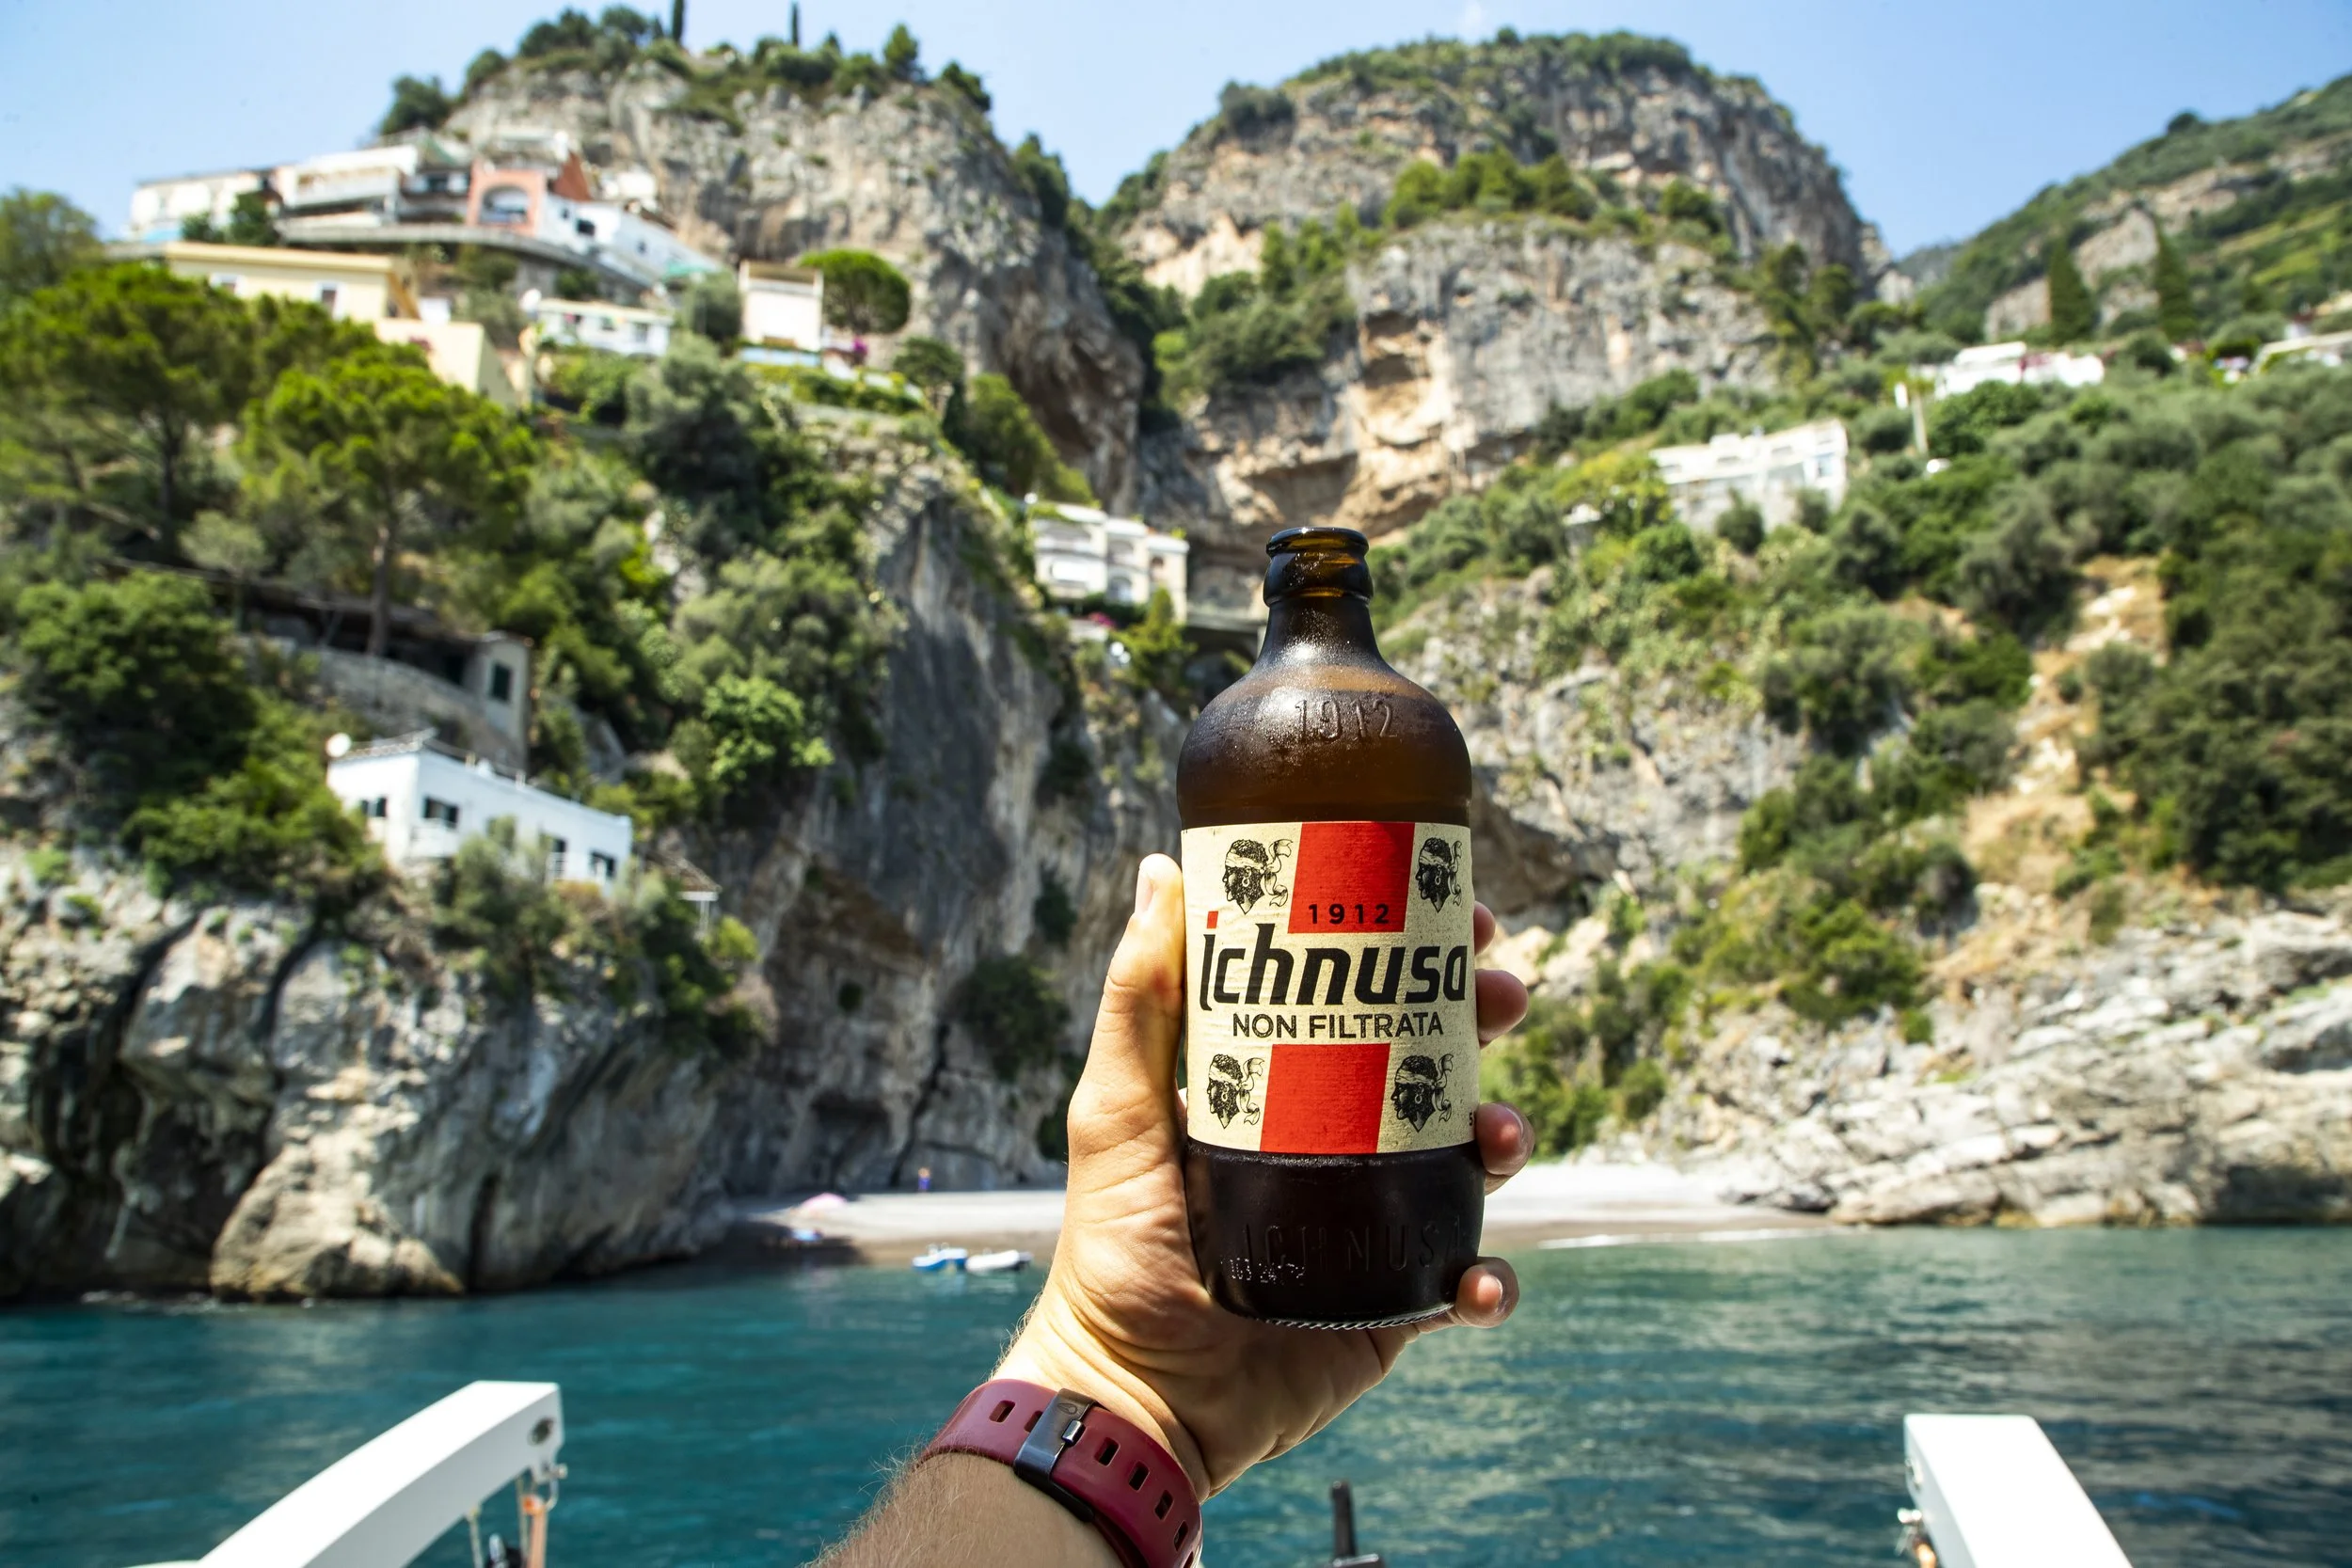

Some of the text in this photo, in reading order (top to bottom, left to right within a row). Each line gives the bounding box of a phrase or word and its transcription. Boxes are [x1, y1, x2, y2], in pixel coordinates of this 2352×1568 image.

[1295, 699, 1397, 741] 1912
[1308, 903, 1391, 925] 1912
[1200, 911, 1468, 1011] ichnusa
[1232, 1011, 1444, 1038] NON FILTRATA
